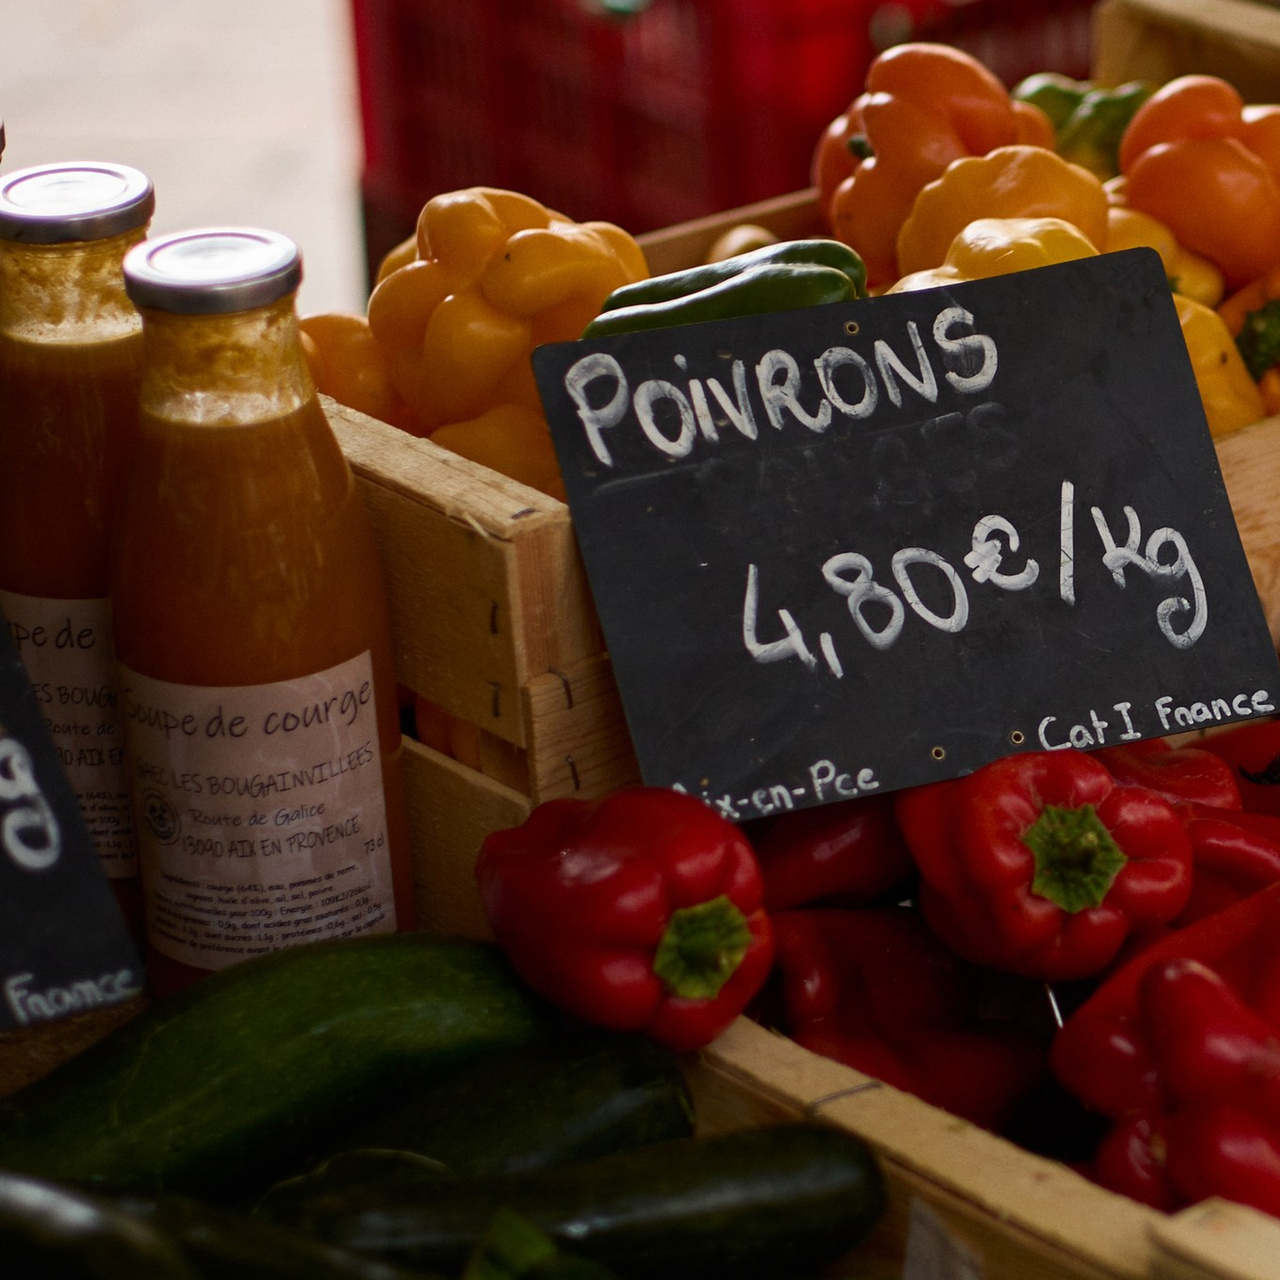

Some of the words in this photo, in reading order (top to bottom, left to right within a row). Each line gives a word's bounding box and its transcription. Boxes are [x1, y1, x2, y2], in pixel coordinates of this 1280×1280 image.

[55, 618, 96, 650] de
[205, 705, 249, 738] de
[263, 680, 371, 735] courge
[1037, 709, 1109, 752] Cat
[1112, 701, 1142, 741] I
[1154, 689, 1276, 731] France
[170, 770, 202, 794] LES
[182, 835, 224, 858] 13090
[227, 839, 257, 858] AIX
[260, 838, 282, 857] EN
[286, 814, 361, 854] PROVENCE
[187, 808, 242, 827] Route
[248, 810, 269, 826] de
[274, 802, 326, 827] Galice
[3, 969, 143, 1026] France
